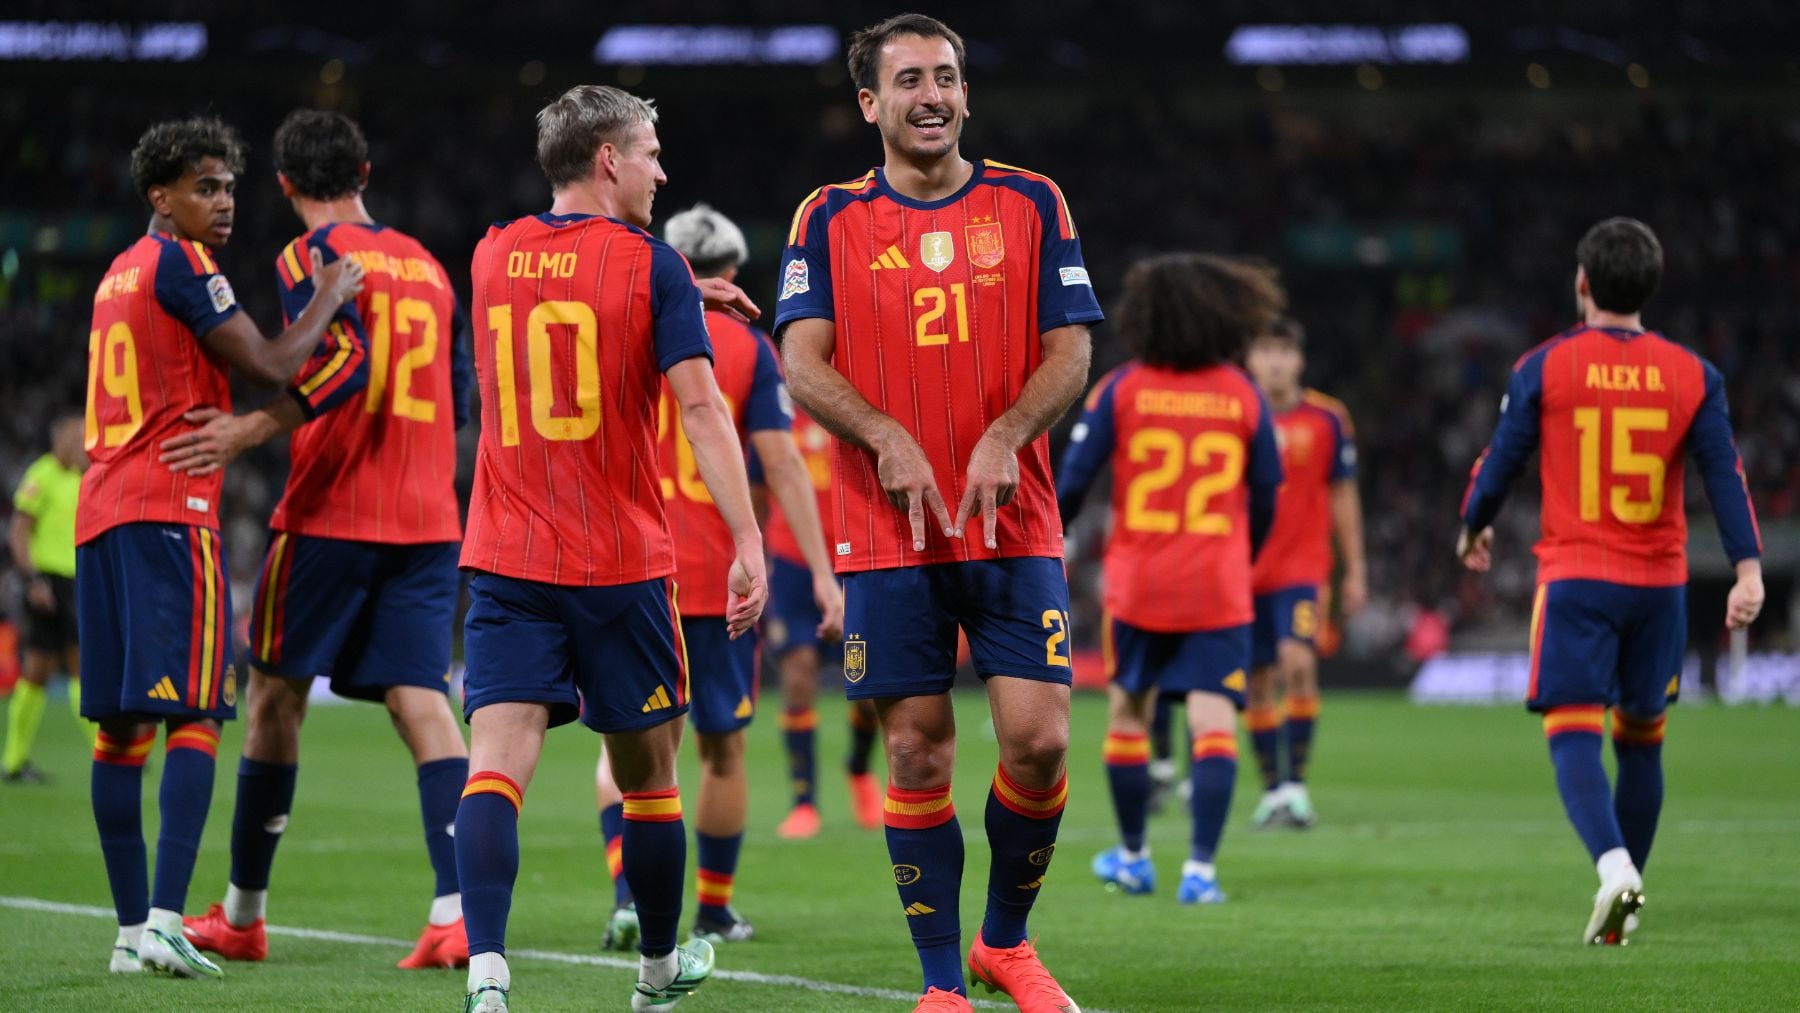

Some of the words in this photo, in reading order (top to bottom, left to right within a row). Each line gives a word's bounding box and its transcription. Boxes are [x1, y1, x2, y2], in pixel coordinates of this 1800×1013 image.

[507, 251, 577, 278] OLMO
[914, 283, 969, 346] 21
[85, 321, 143, 451] 19
[365, 291, 438, 423] 12
[488, 300, 600, 447] 10
[1586, 363, 1640, 391] ALEX
[1125, 428, 1244, 534] 22
[1574, 407, 1669, 523] 15
[1042, 610, 1072, 668] 2
